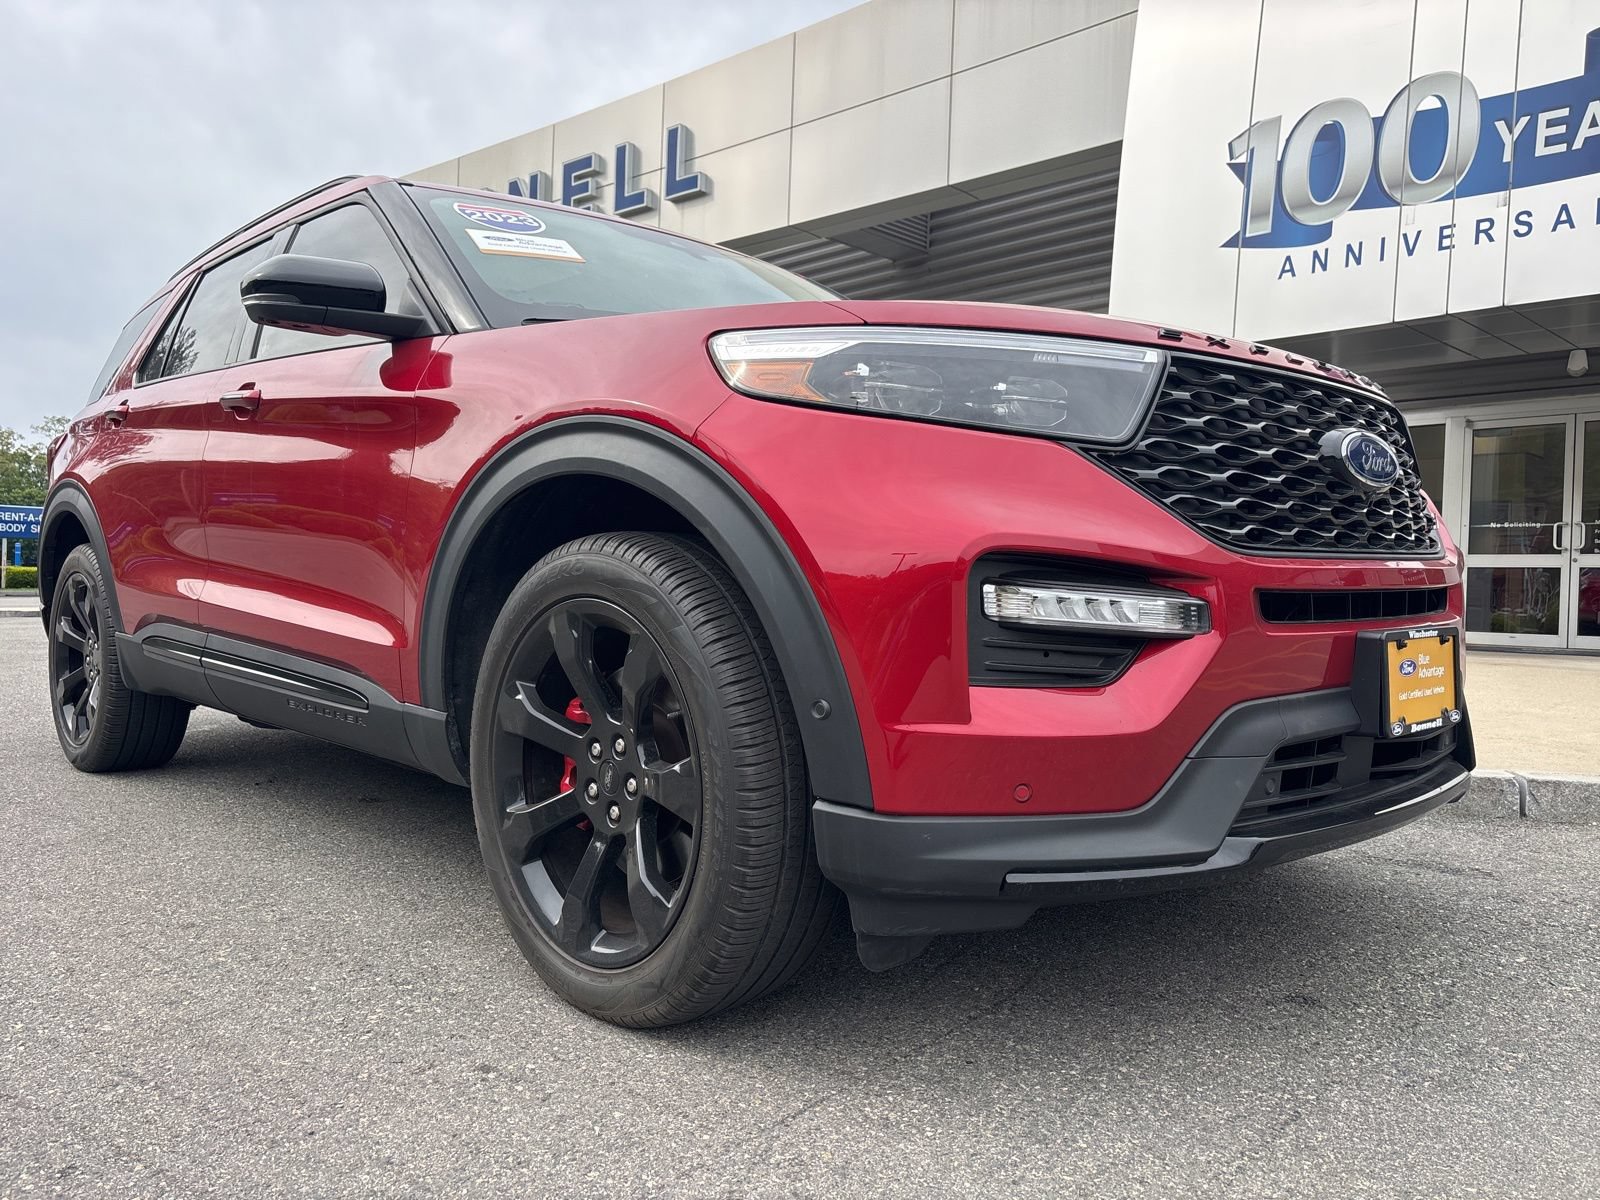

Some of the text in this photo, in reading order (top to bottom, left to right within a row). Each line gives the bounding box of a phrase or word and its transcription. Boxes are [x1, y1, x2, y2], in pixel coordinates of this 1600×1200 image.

[1228, 71, 1481, 238] 100
[464, 209, 540, 227] 2023
[1278, 197, 1600, 280] ANNIVERSA
[0, 522, 27, 533] BODY
[1409, 630, 1438, 639] Winchester
[1418, 653, 1430, 665] Blue
[1418, 666, 1445, 678] Advantage
[1398, 691, 1408, 701] Gold
[287, 699, 367, 727] EXPLORER
[1411, 718, 1442, 733] Bonnell
